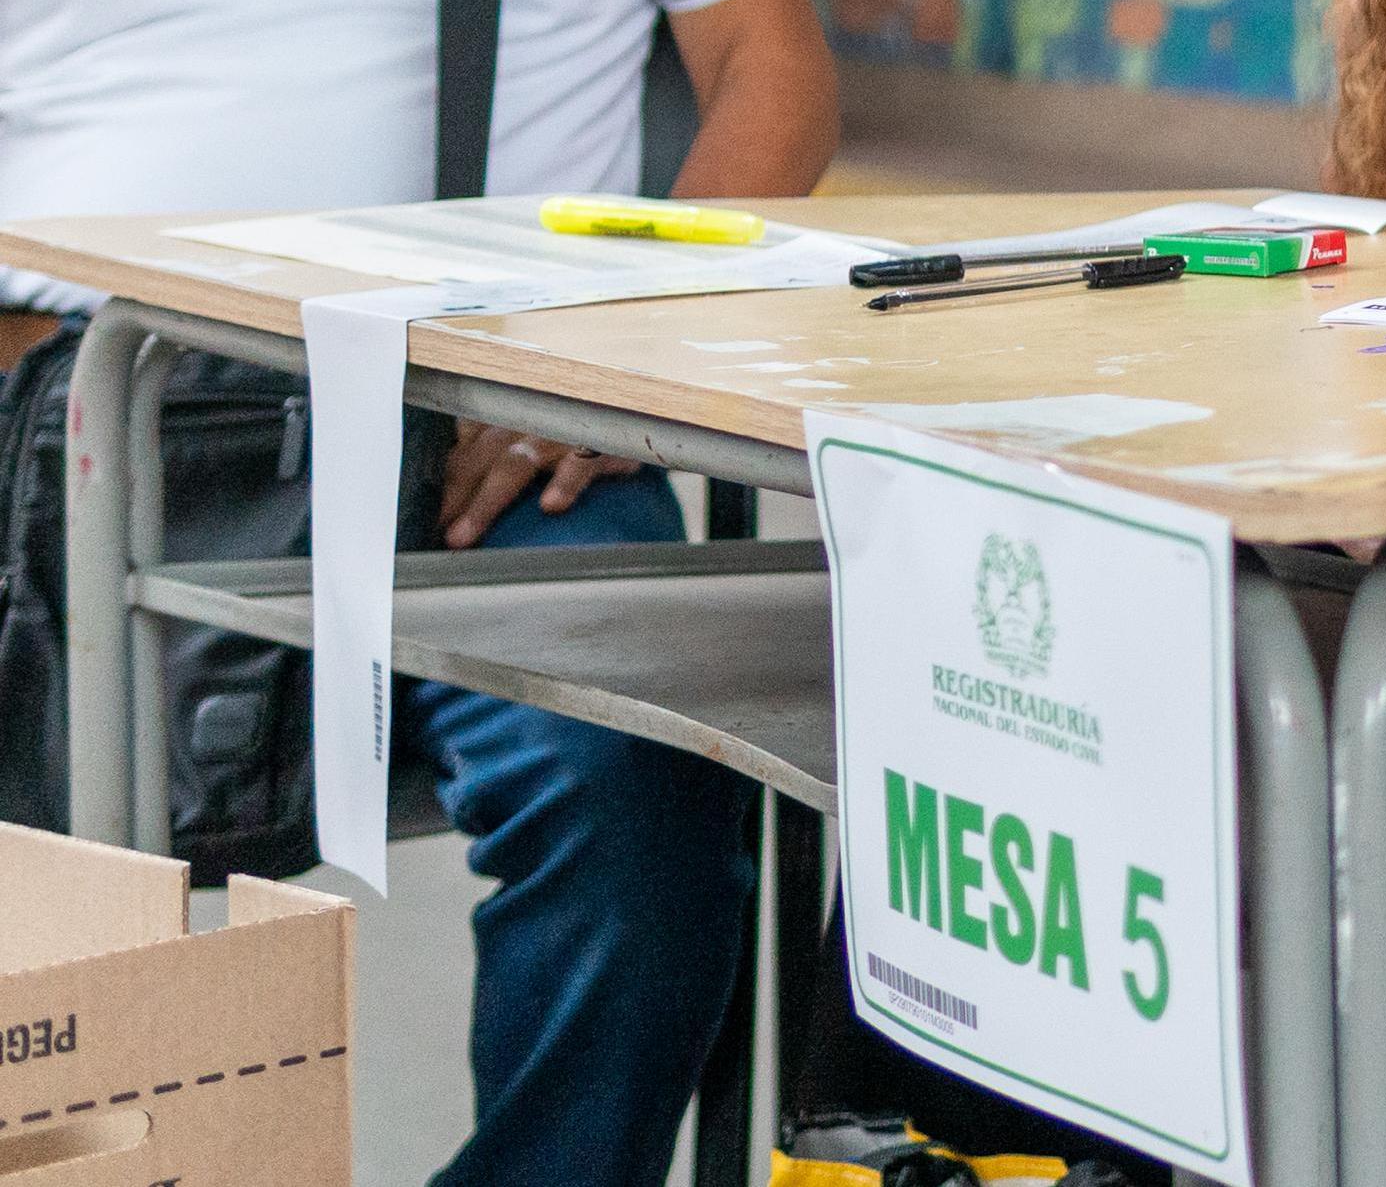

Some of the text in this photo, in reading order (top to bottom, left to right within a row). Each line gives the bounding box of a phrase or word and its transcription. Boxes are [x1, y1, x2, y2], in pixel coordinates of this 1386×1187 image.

[1312, 246, 1343, 260] Penmax
[931, 663, 1102, 744] REGISTRADURÍA
[932, 695, 992, 729] NACIONAL
[996, 715, 1020, 737] DEL
[884, 766, 1170, 1023] MESA 5
[0, 1013, 76, 1066] PEG
